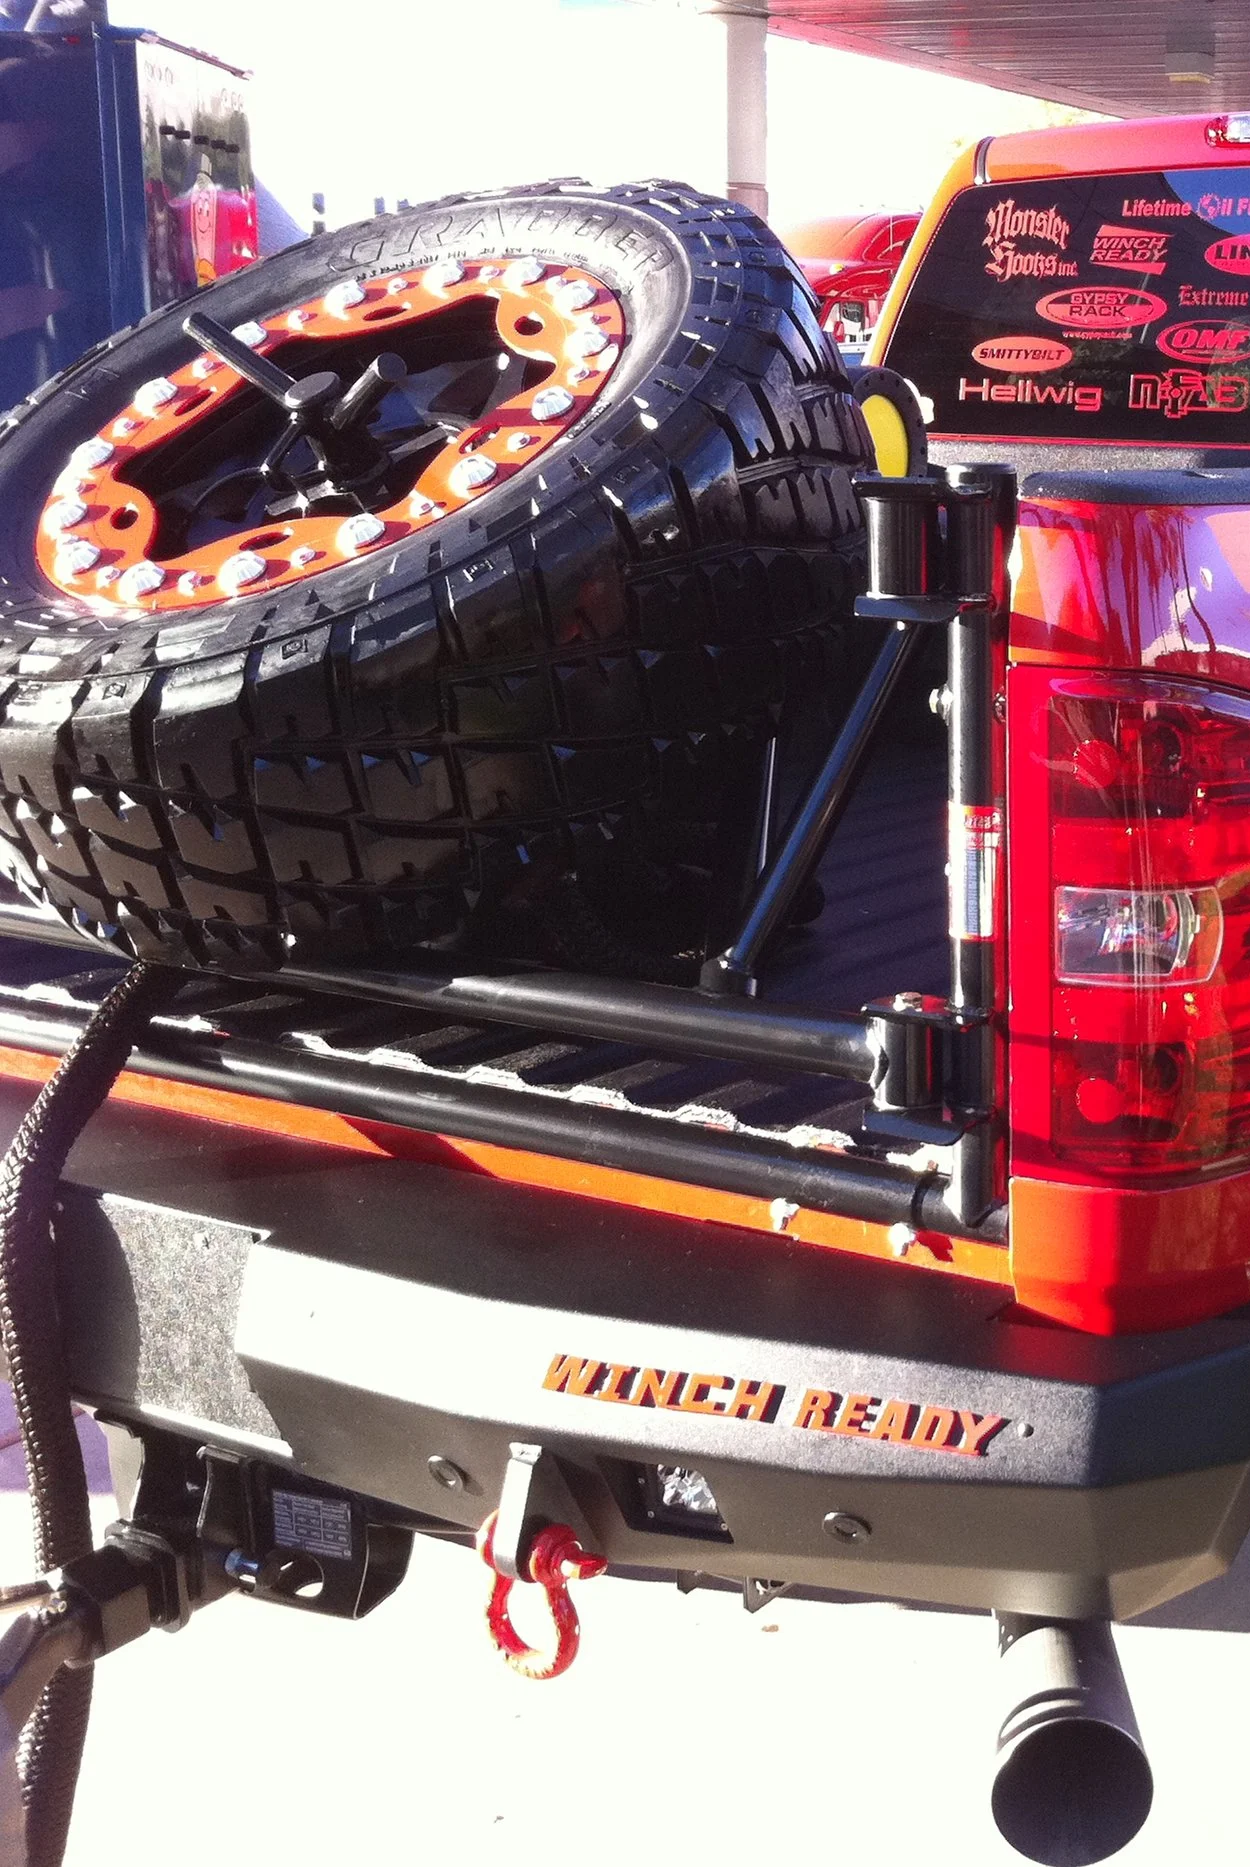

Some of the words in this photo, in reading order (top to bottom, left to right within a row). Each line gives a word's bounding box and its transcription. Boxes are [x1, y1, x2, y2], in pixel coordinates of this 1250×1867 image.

[1122, 198, 1192, 217] Lifetime
[984, 198, 1070, 250] Monster
[1093, 236, 1167, 250] WINCH
[982, 237, 1059, 283] Hooks
[1089, 249, 1168, 262] READY
[1070, 292, 1130, 305] GYPSY
[1178, 285, 1248, 307] Extreme
[1068, 305, 1127, 318] RACK
[1171, 328, 1250, 350] OMF
[979, 347, 1065, 361] SMITTYBILT
[958, 376, 1103, 412] Hellwig
[541, 1352, 786, 1424] WINCH
[792, 1386, 1008, 1457] READY
